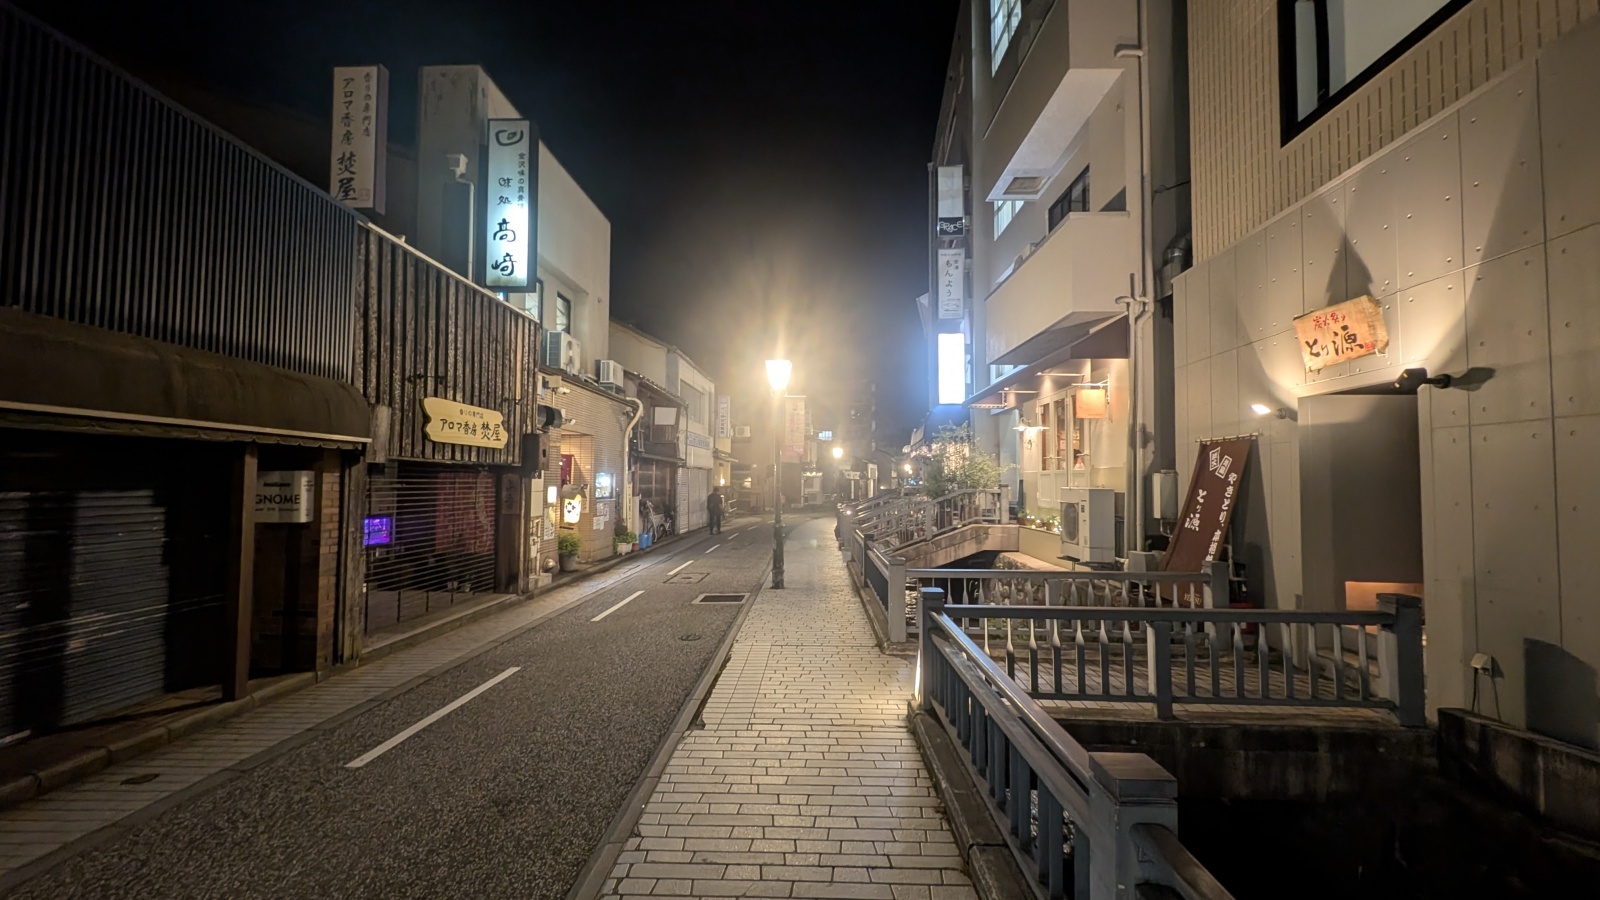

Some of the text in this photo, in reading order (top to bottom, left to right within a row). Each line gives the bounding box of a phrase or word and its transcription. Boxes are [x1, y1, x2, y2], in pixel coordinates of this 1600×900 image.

[335, 77, 358, 201] アロマ香房 焚屋
[498, 176, 513, 205] 味処
[517, 152, 526, 209] 金沢味の真骨
[944, 259, 954, 297] もんよう
[1305, 324, 1365, 358] とり源
[440, 418, 501, 442] アロマ香房 焚屋
[1184, 489, 1207, 531] とり源
